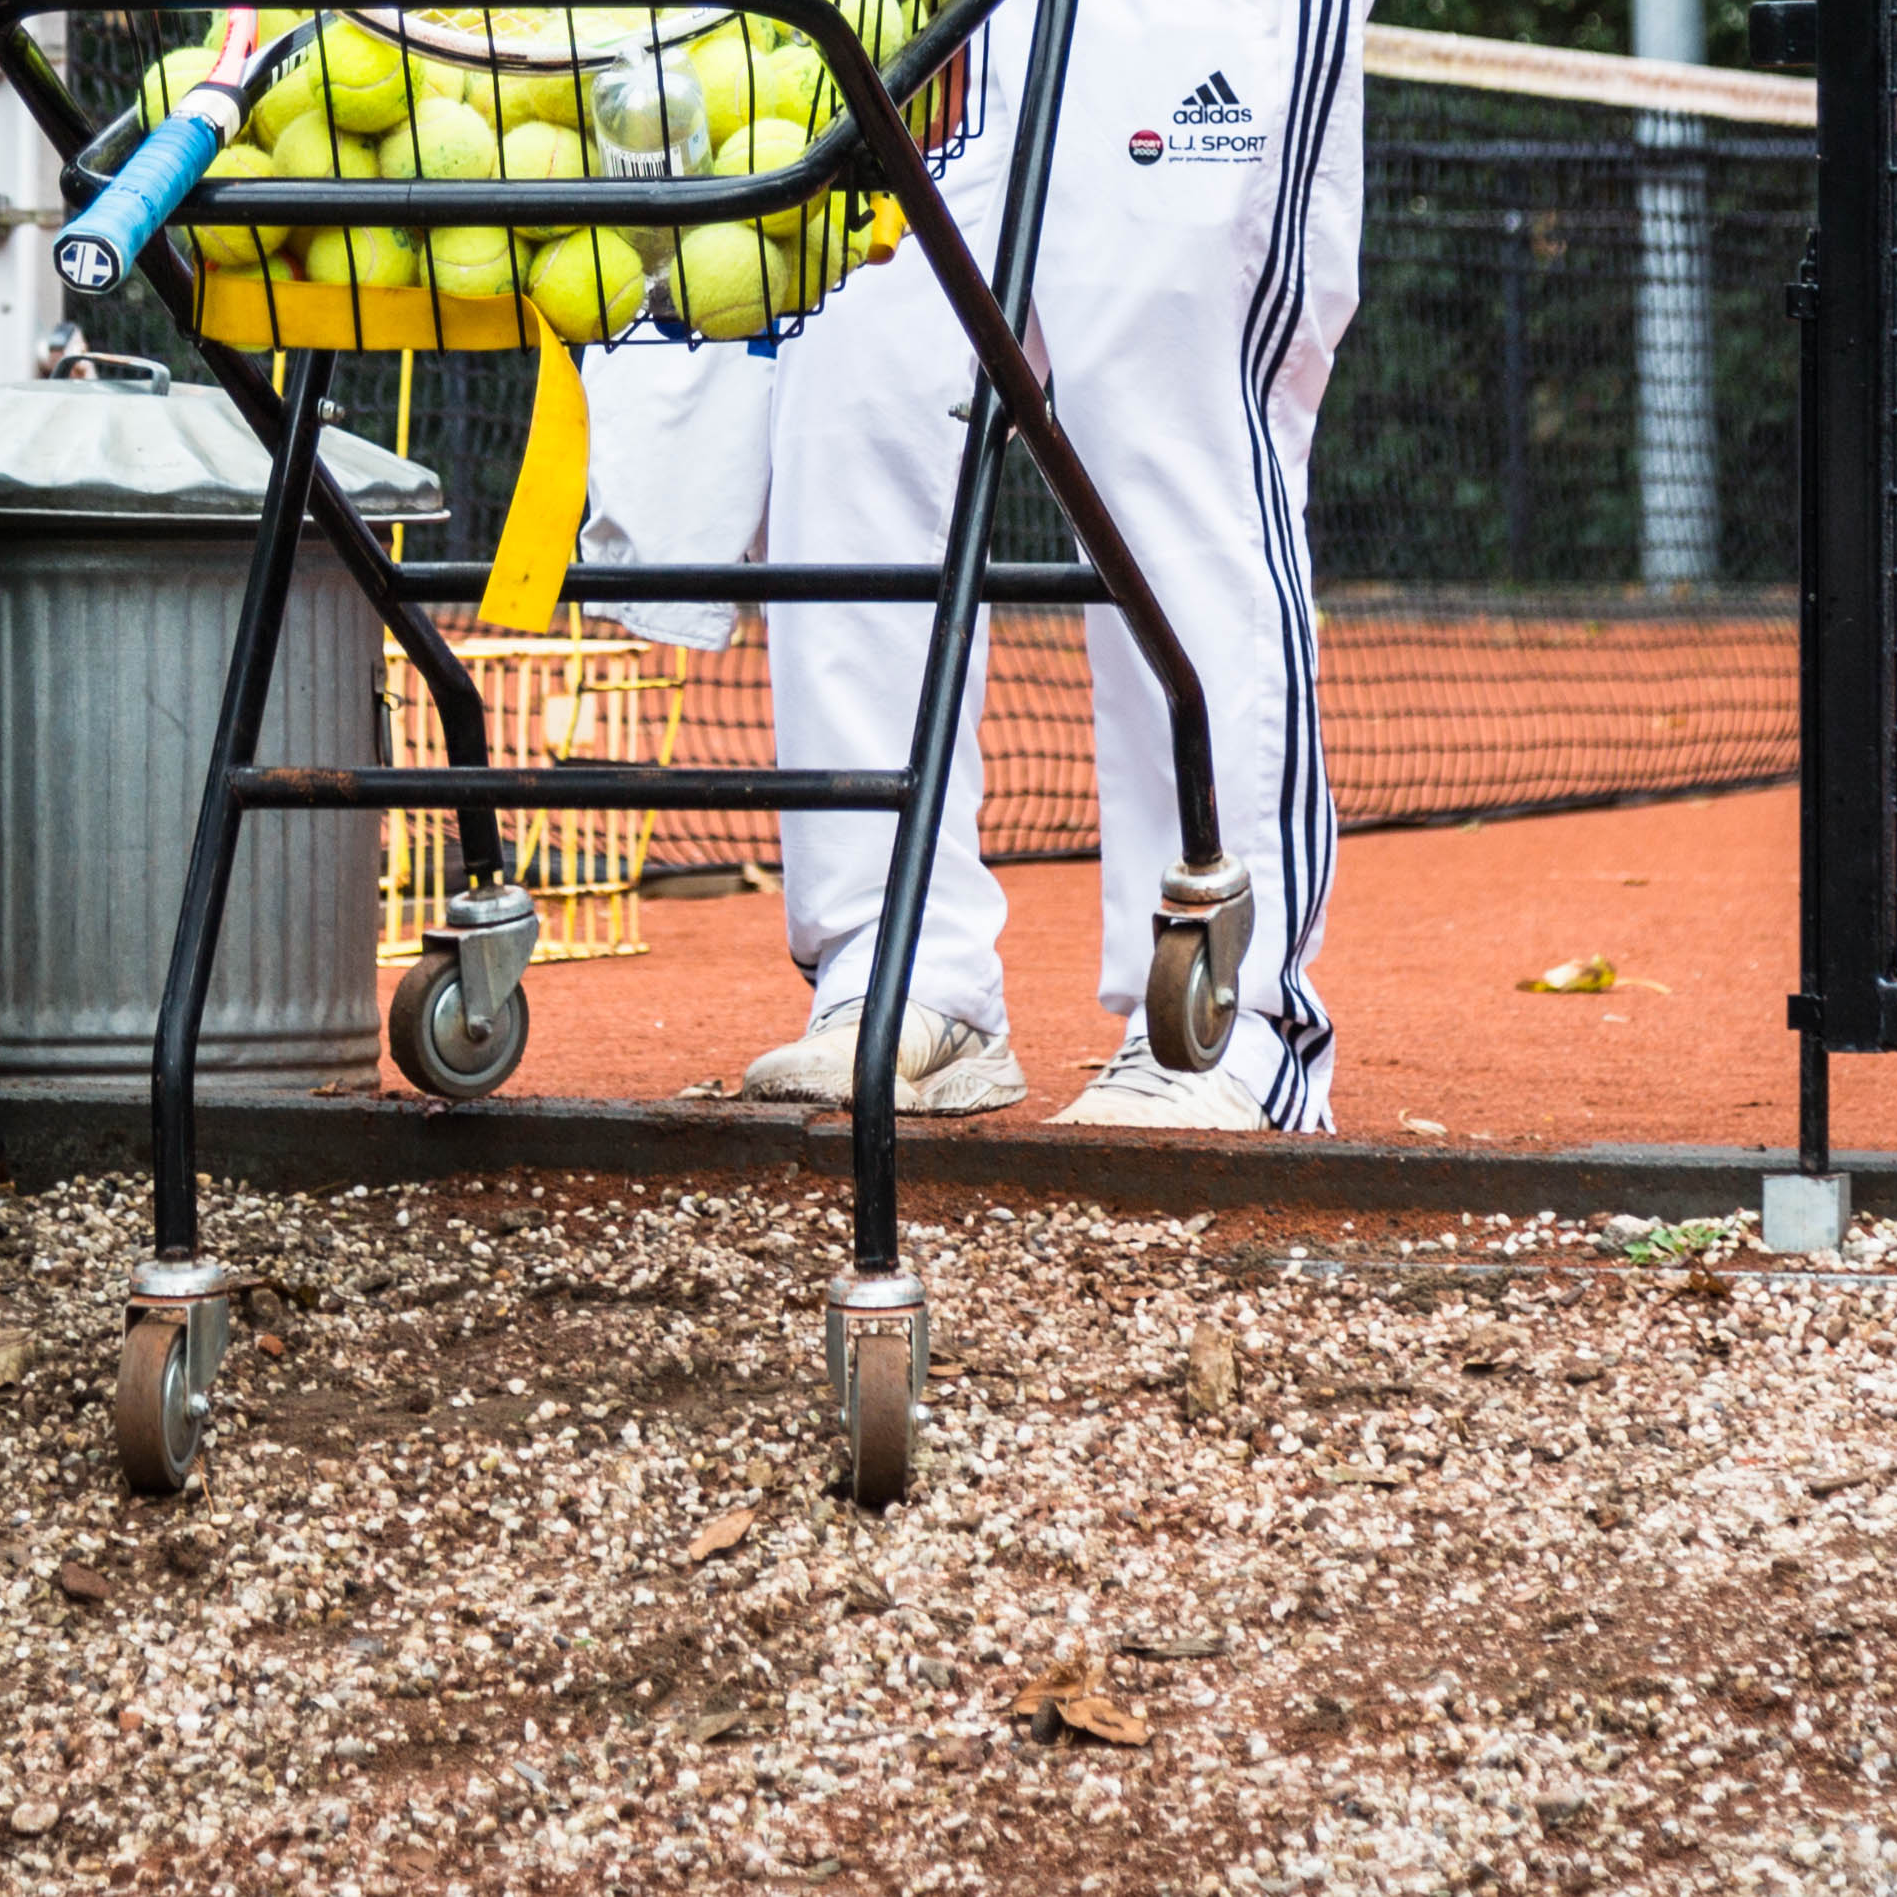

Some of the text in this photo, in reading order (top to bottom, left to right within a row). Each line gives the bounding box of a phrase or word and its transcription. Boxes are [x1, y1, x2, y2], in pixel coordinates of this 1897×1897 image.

[1173, 105, 1253, 124] adidas
[1131, 139, 1162, 149] SPORT
[1202, 136, 1268, 151] SPORT
[1133, 148, 1159, 157] 2000
